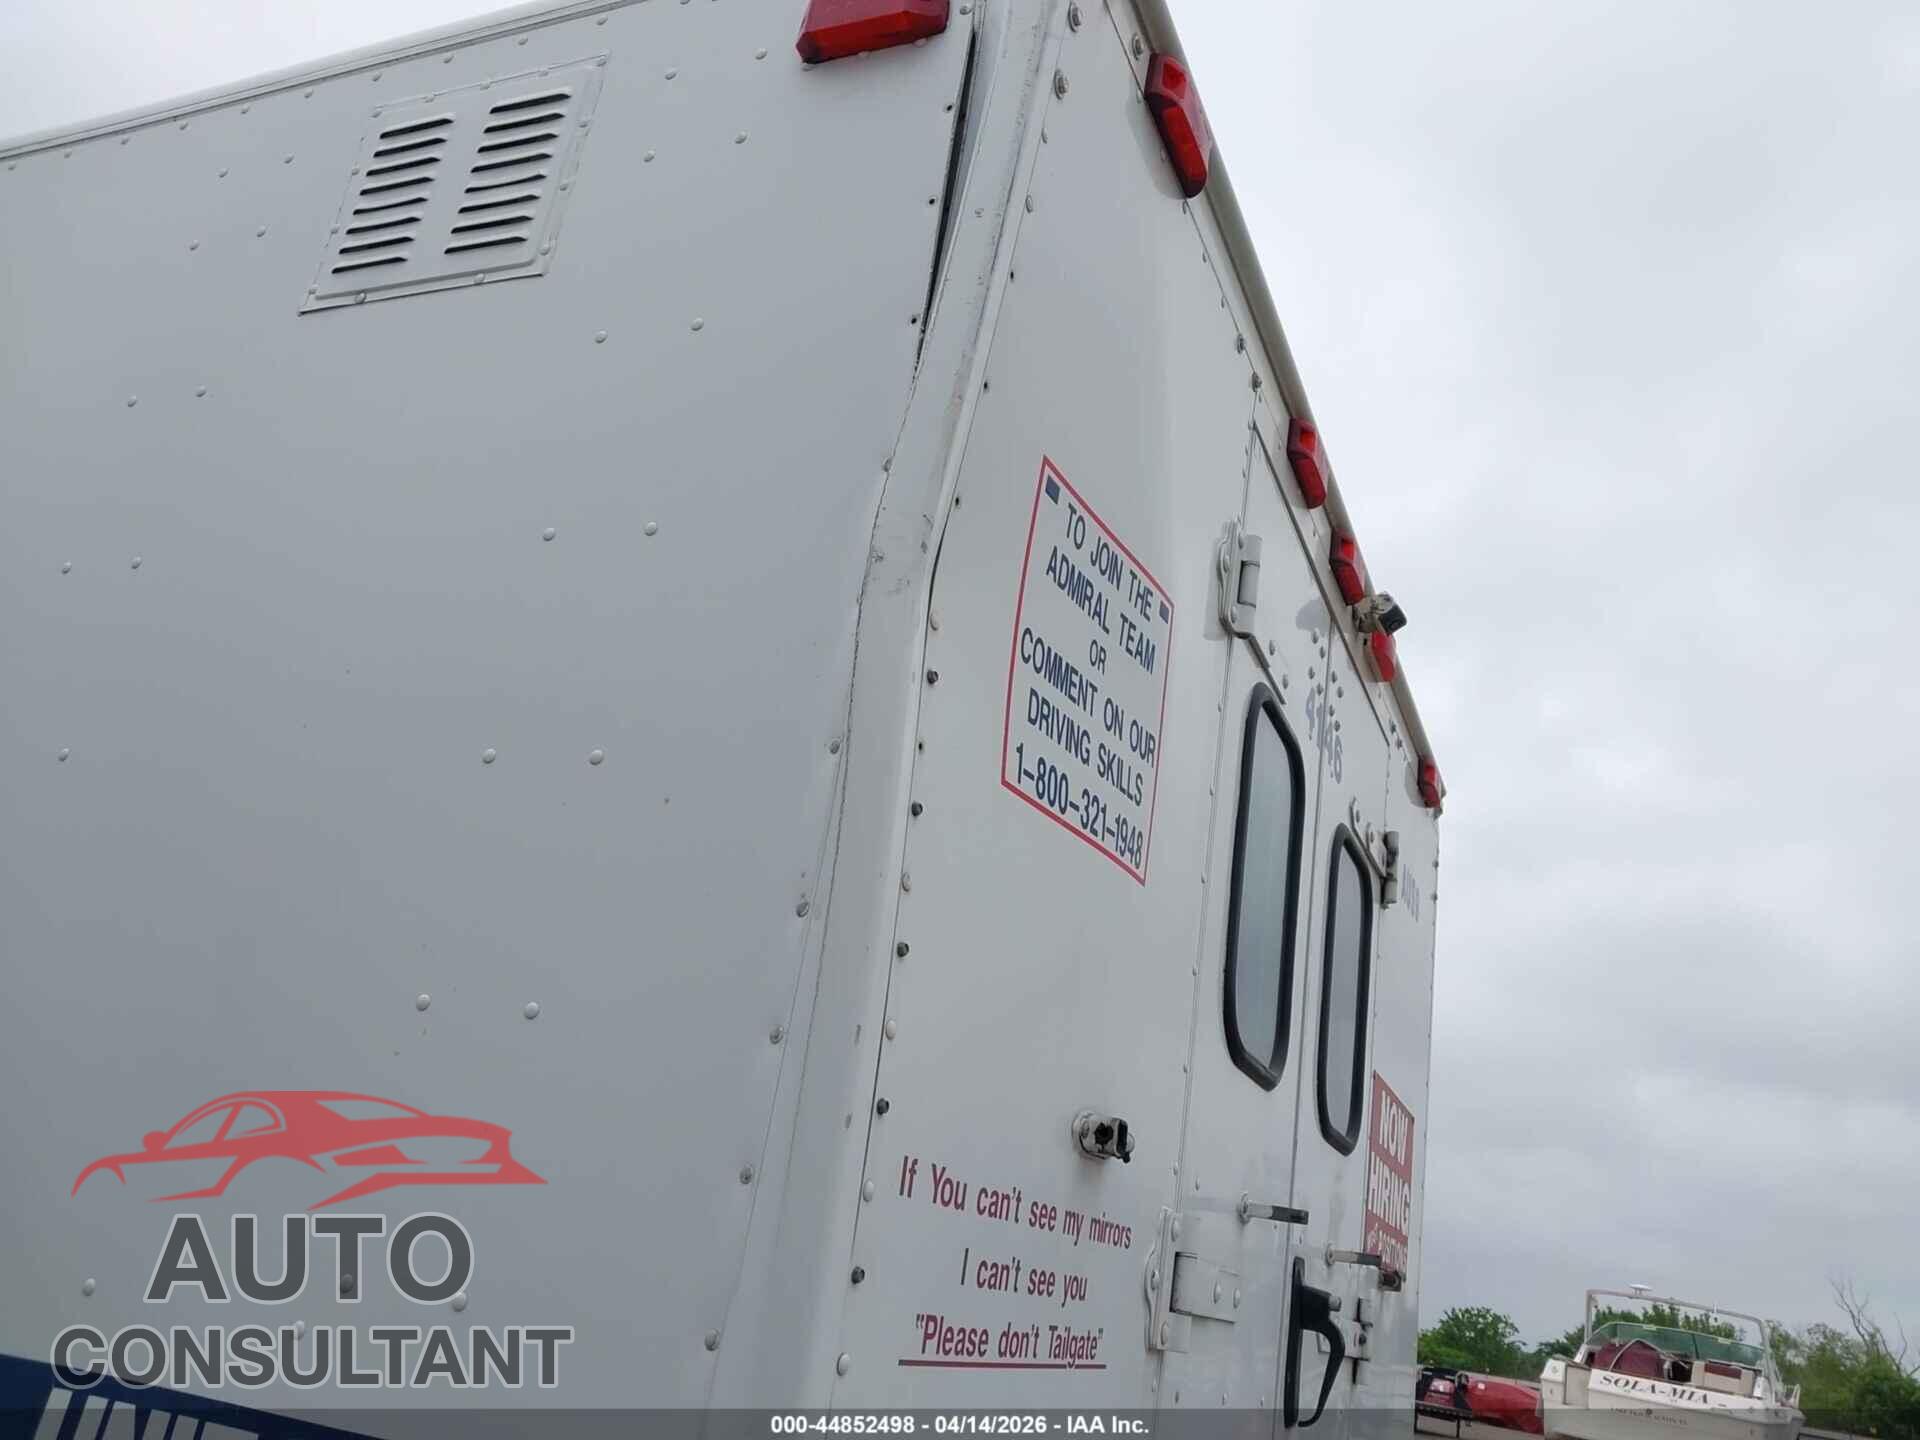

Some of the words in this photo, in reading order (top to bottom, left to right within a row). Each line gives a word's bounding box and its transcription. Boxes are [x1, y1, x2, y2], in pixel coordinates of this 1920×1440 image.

[1066, 502, 1086, 550] TO
[1090, 535, 1123, 591] JOIN
[1129, 567, 1153, 623] THE
[1046, 546, 1109, 635] ADMIRAL
[1119, 611, 1155, 675] TEAM
[1089, 639, 1106, 675] OR
[1020, 627, 1098, 718] COMMENT
[1103, 697, 1123, 742] ON
[1129, 719, 1155, 769] OUR
[1028, 687, 1090, 767] DRIVING
[1097, 742, 1143, 807] SKILLS
[1016, 742, 1143, 870] 1-800-321-1948
[1379, 1089, 1408, 1166] NOW
[899, 1155, 918, 1198] If
[931, 1163, 967, 1211] You
[976, 1187, 1022, 1224] can't
[1029, 1200, 1057, 1232] see
[1063, 1210, 1084, 1246] my
[1089, 1212, 1132, 1249] mirrors
[1368, 1152, 1410, 1236] HIRING
[961, 1248, 969, 1286] I
[976, 1256, 1021, 1292] can't
[1028, 1268, 1056, 1297] see
[1062, 1274, 1088, 1307] you
[916, 1314, 989, 1358] "Please
[998, 1322, 1040, 1359] don't
[1048, 1325, 1104, 1368] Tailgate"
